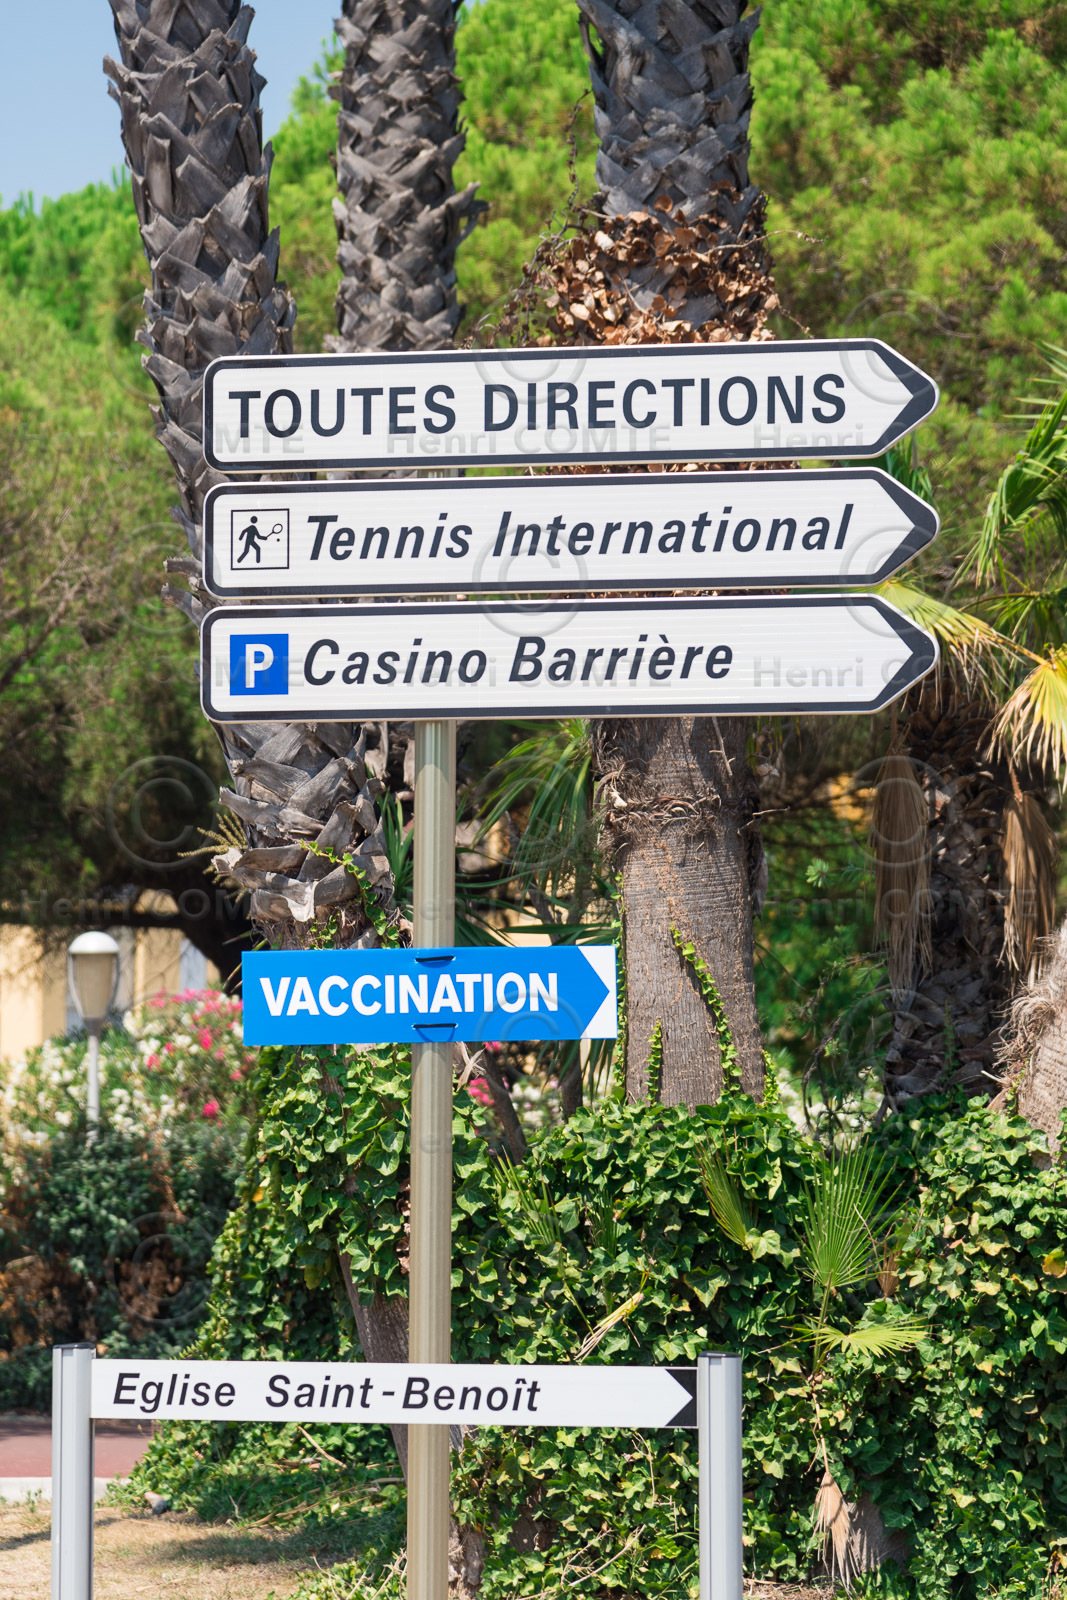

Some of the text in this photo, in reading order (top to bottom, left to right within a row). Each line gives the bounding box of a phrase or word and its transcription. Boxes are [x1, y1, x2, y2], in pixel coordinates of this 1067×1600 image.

[229, 373, 846, 438] TOUTES DIRECTIONS
[307, 503, 854, 561] Tennis International
[245, 643, 275, 689] P
[303, 634, 733, 686] Casino Barrière
[259, 972, 558, 1017] VACCINATION
[113, 1372, 541, 1414] Eglise Saint-Benoît
